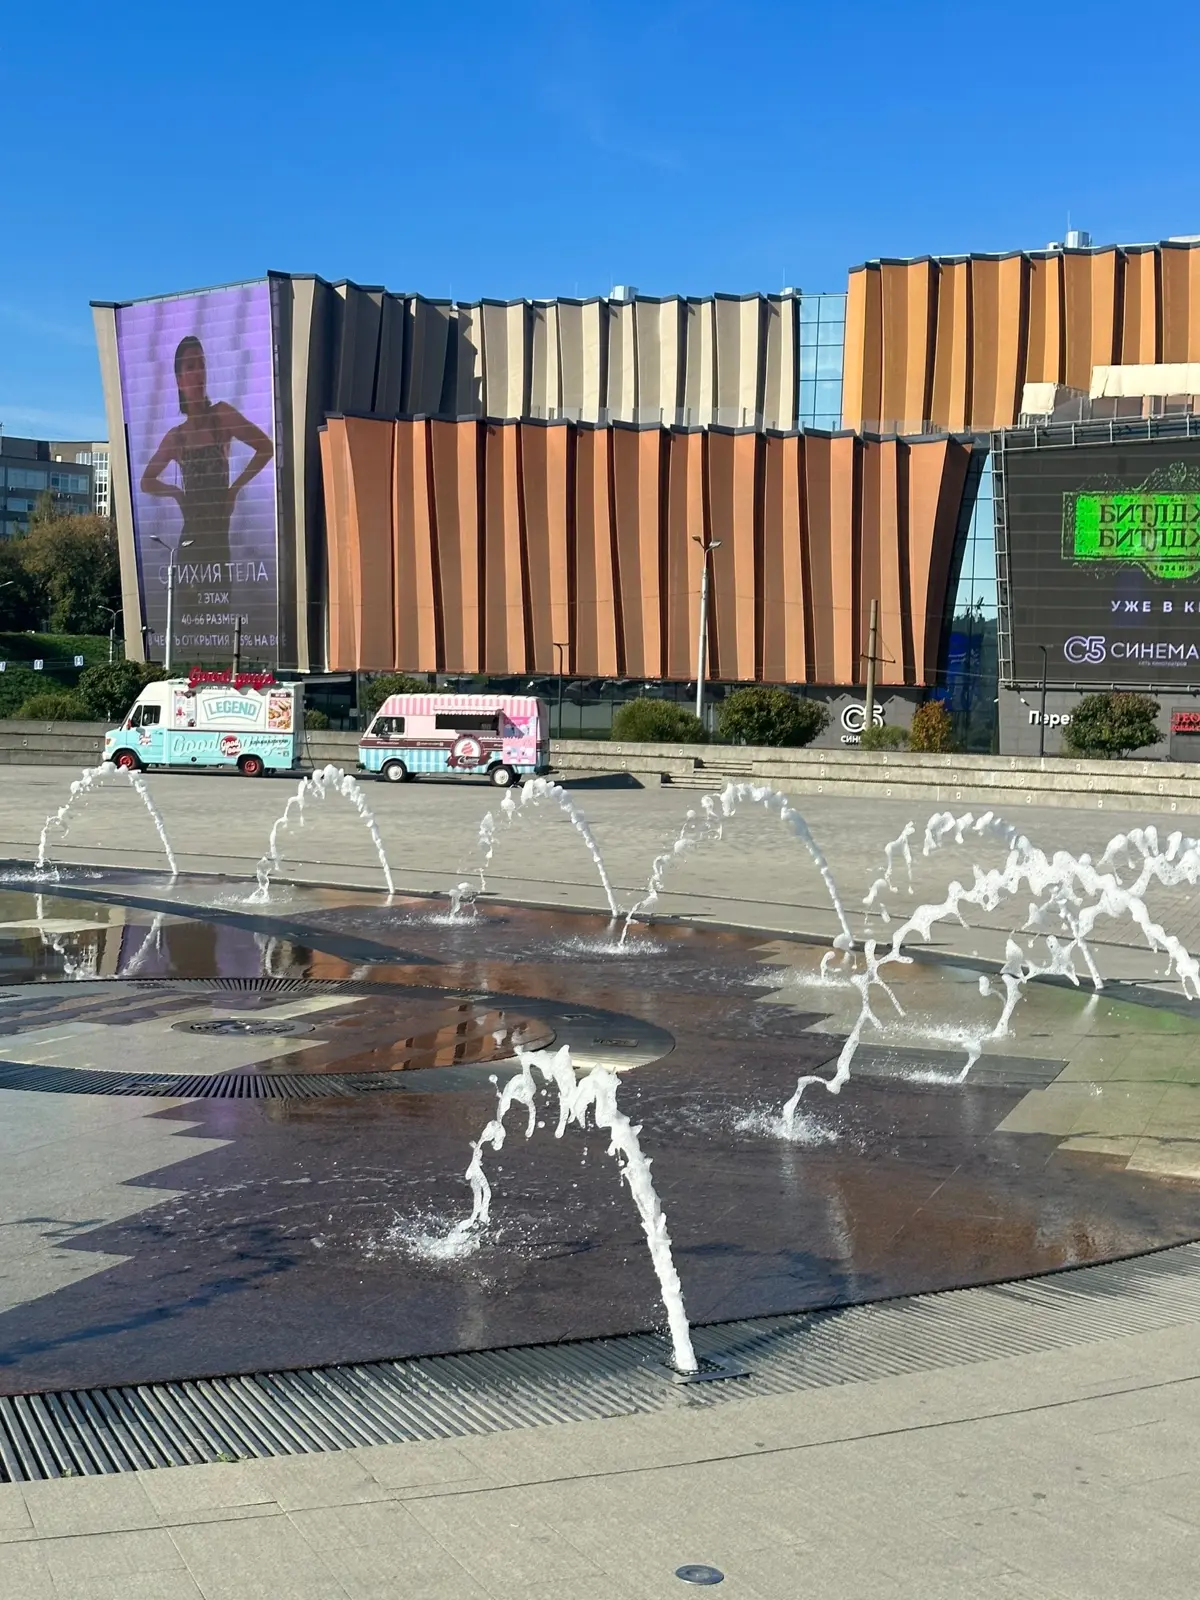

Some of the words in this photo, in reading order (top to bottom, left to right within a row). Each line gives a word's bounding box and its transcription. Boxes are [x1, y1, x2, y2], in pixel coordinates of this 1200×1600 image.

[225, 561, 269, 582] ТЕЛА
[204, 592, 230, 604] ЭТАЖ
[1111, 600, 1151, 612] УЖЕ
[1163, 601, 1173, 612] В
[181, 613, 205, 625] 40-66
[181, 634, 230, 646] ОТКРЫТИЯ
[254, 634, 269, 646] НА
[1111, 642, 1200, 660] СИНЕМА
[208, 699, 257, 716] LEGEND
